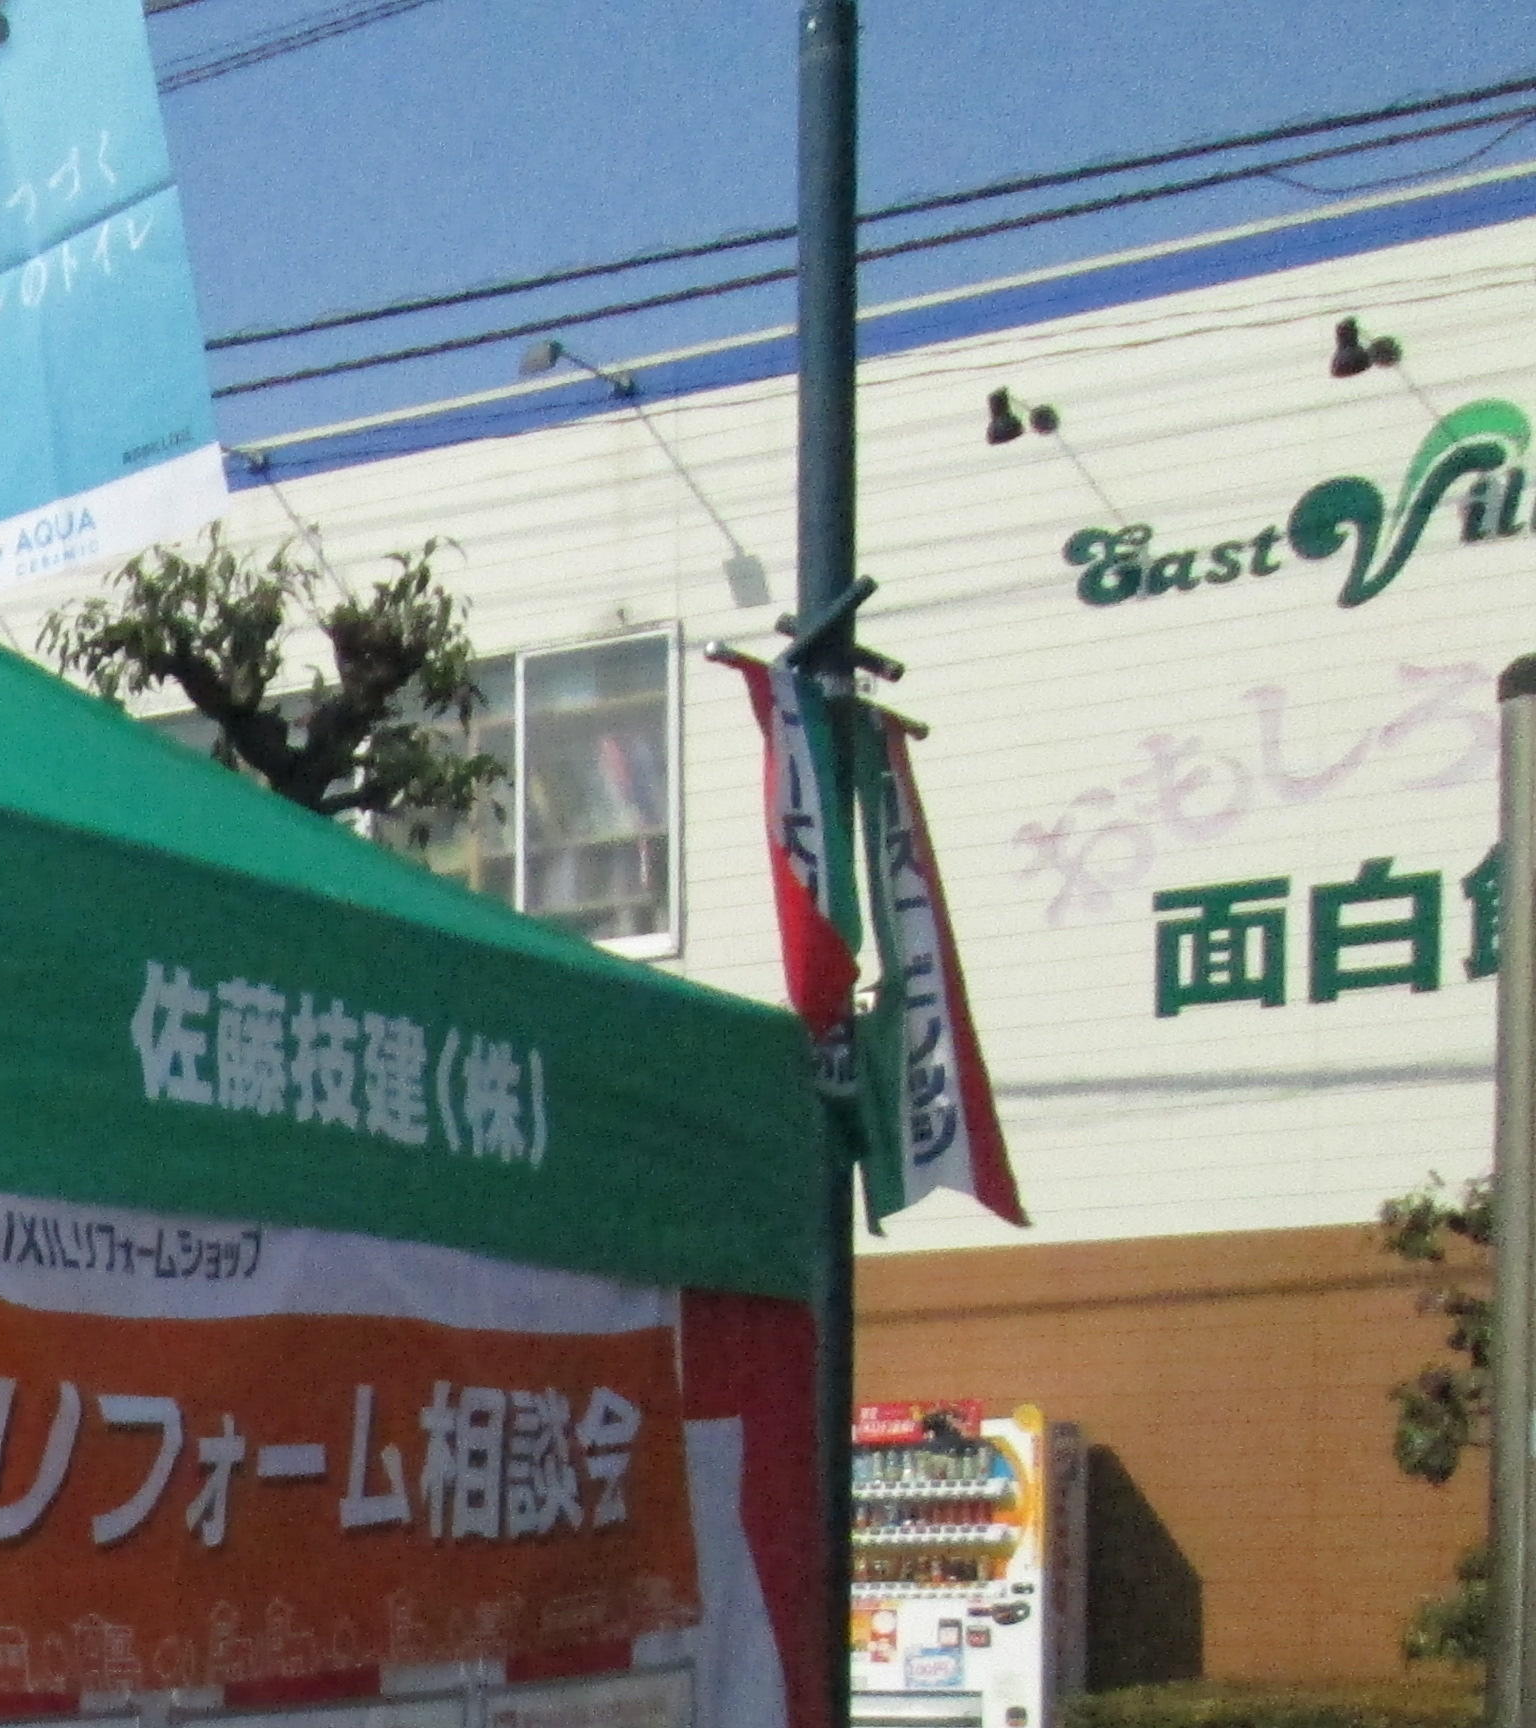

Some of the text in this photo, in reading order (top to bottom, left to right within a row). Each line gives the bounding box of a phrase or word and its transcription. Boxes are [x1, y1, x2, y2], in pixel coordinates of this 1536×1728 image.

[15, 507, 97, 553] AQUA
[1060, 523, 1287, 607] East
[130, 958, 549, 1170] 佐藤技建(株)
